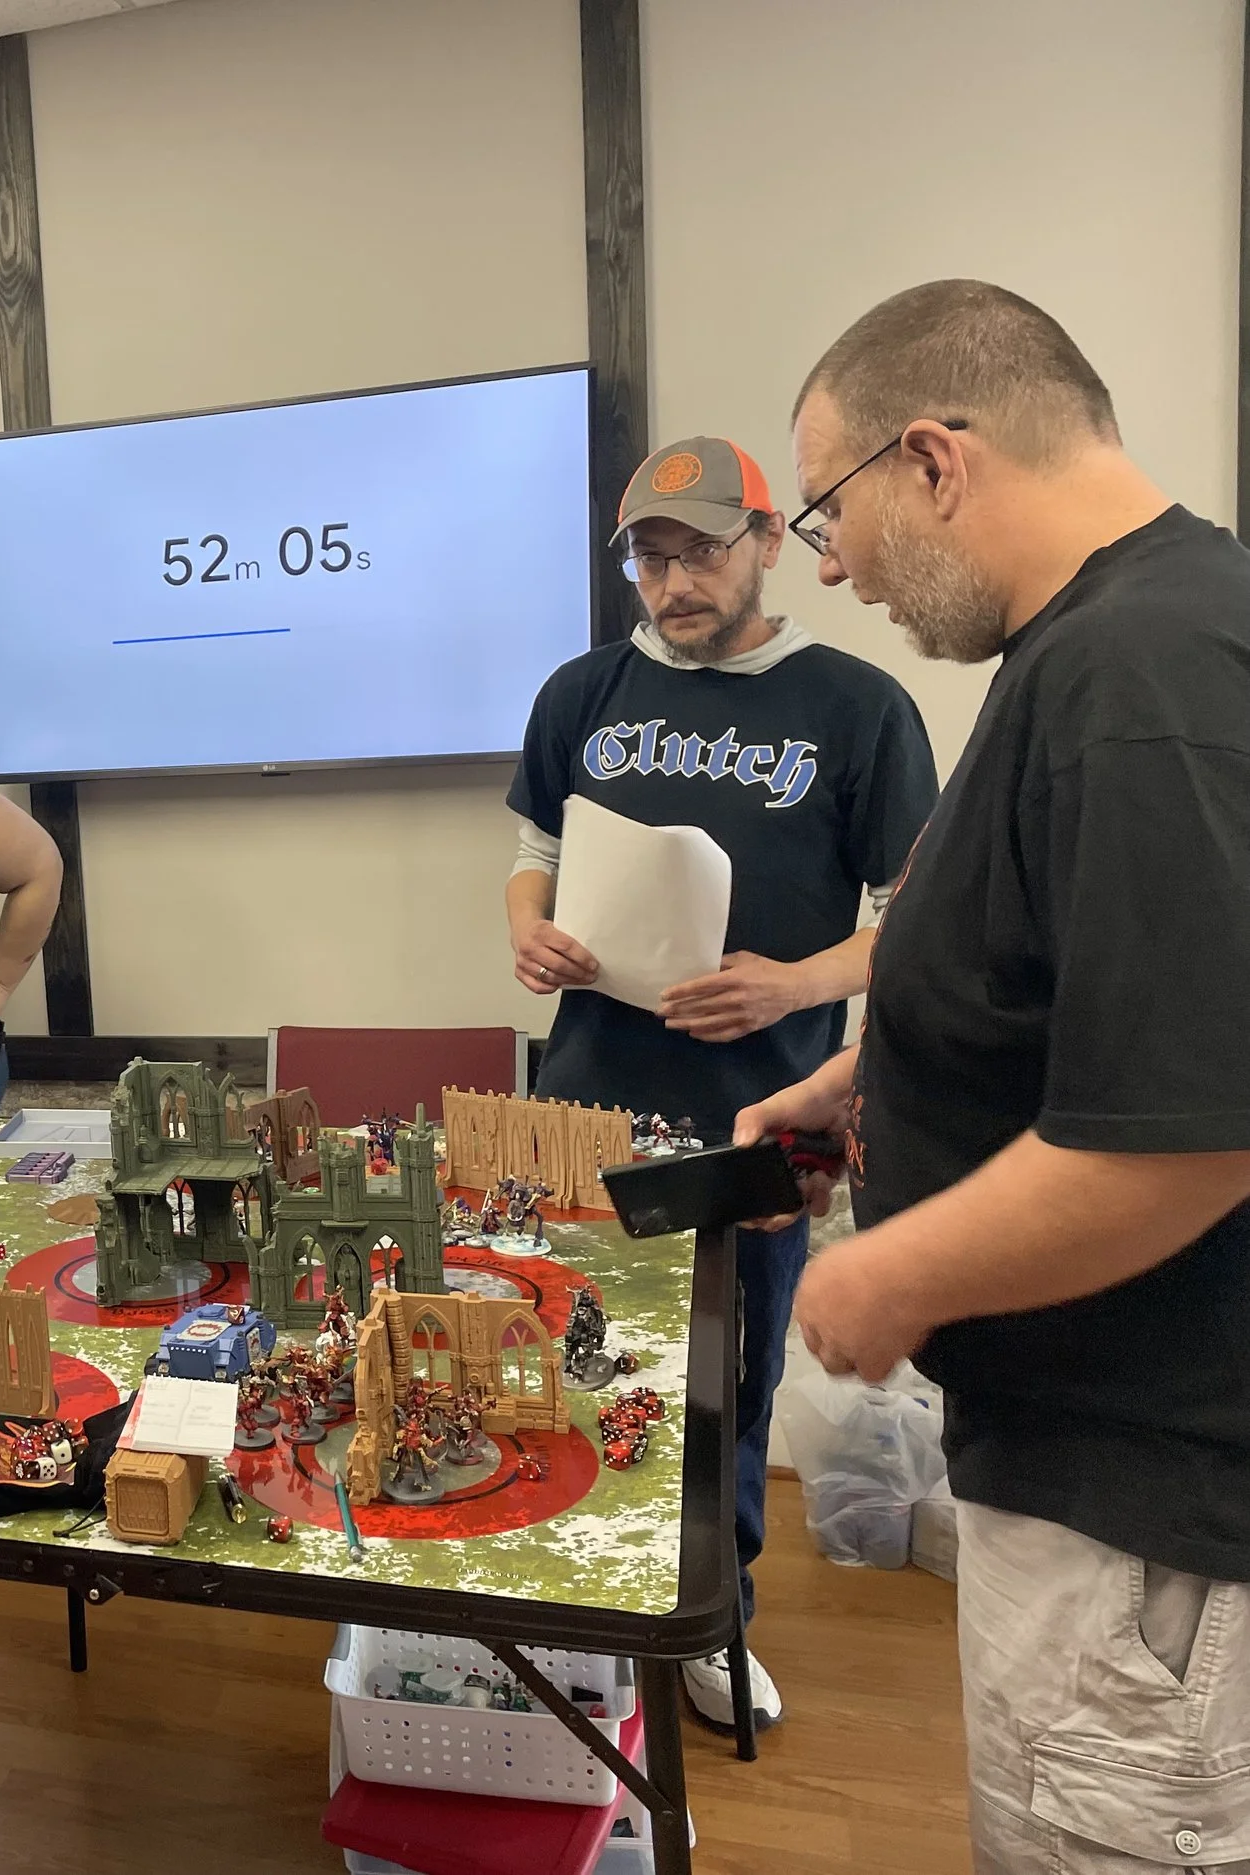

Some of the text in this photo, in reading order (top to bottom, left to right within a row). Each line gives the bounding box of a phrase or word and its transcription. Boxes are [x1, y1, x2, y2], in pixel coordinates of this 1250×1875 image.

[163, 522, 372, 587] 52m 05s
[583, 719, 818, 808] Clutch
